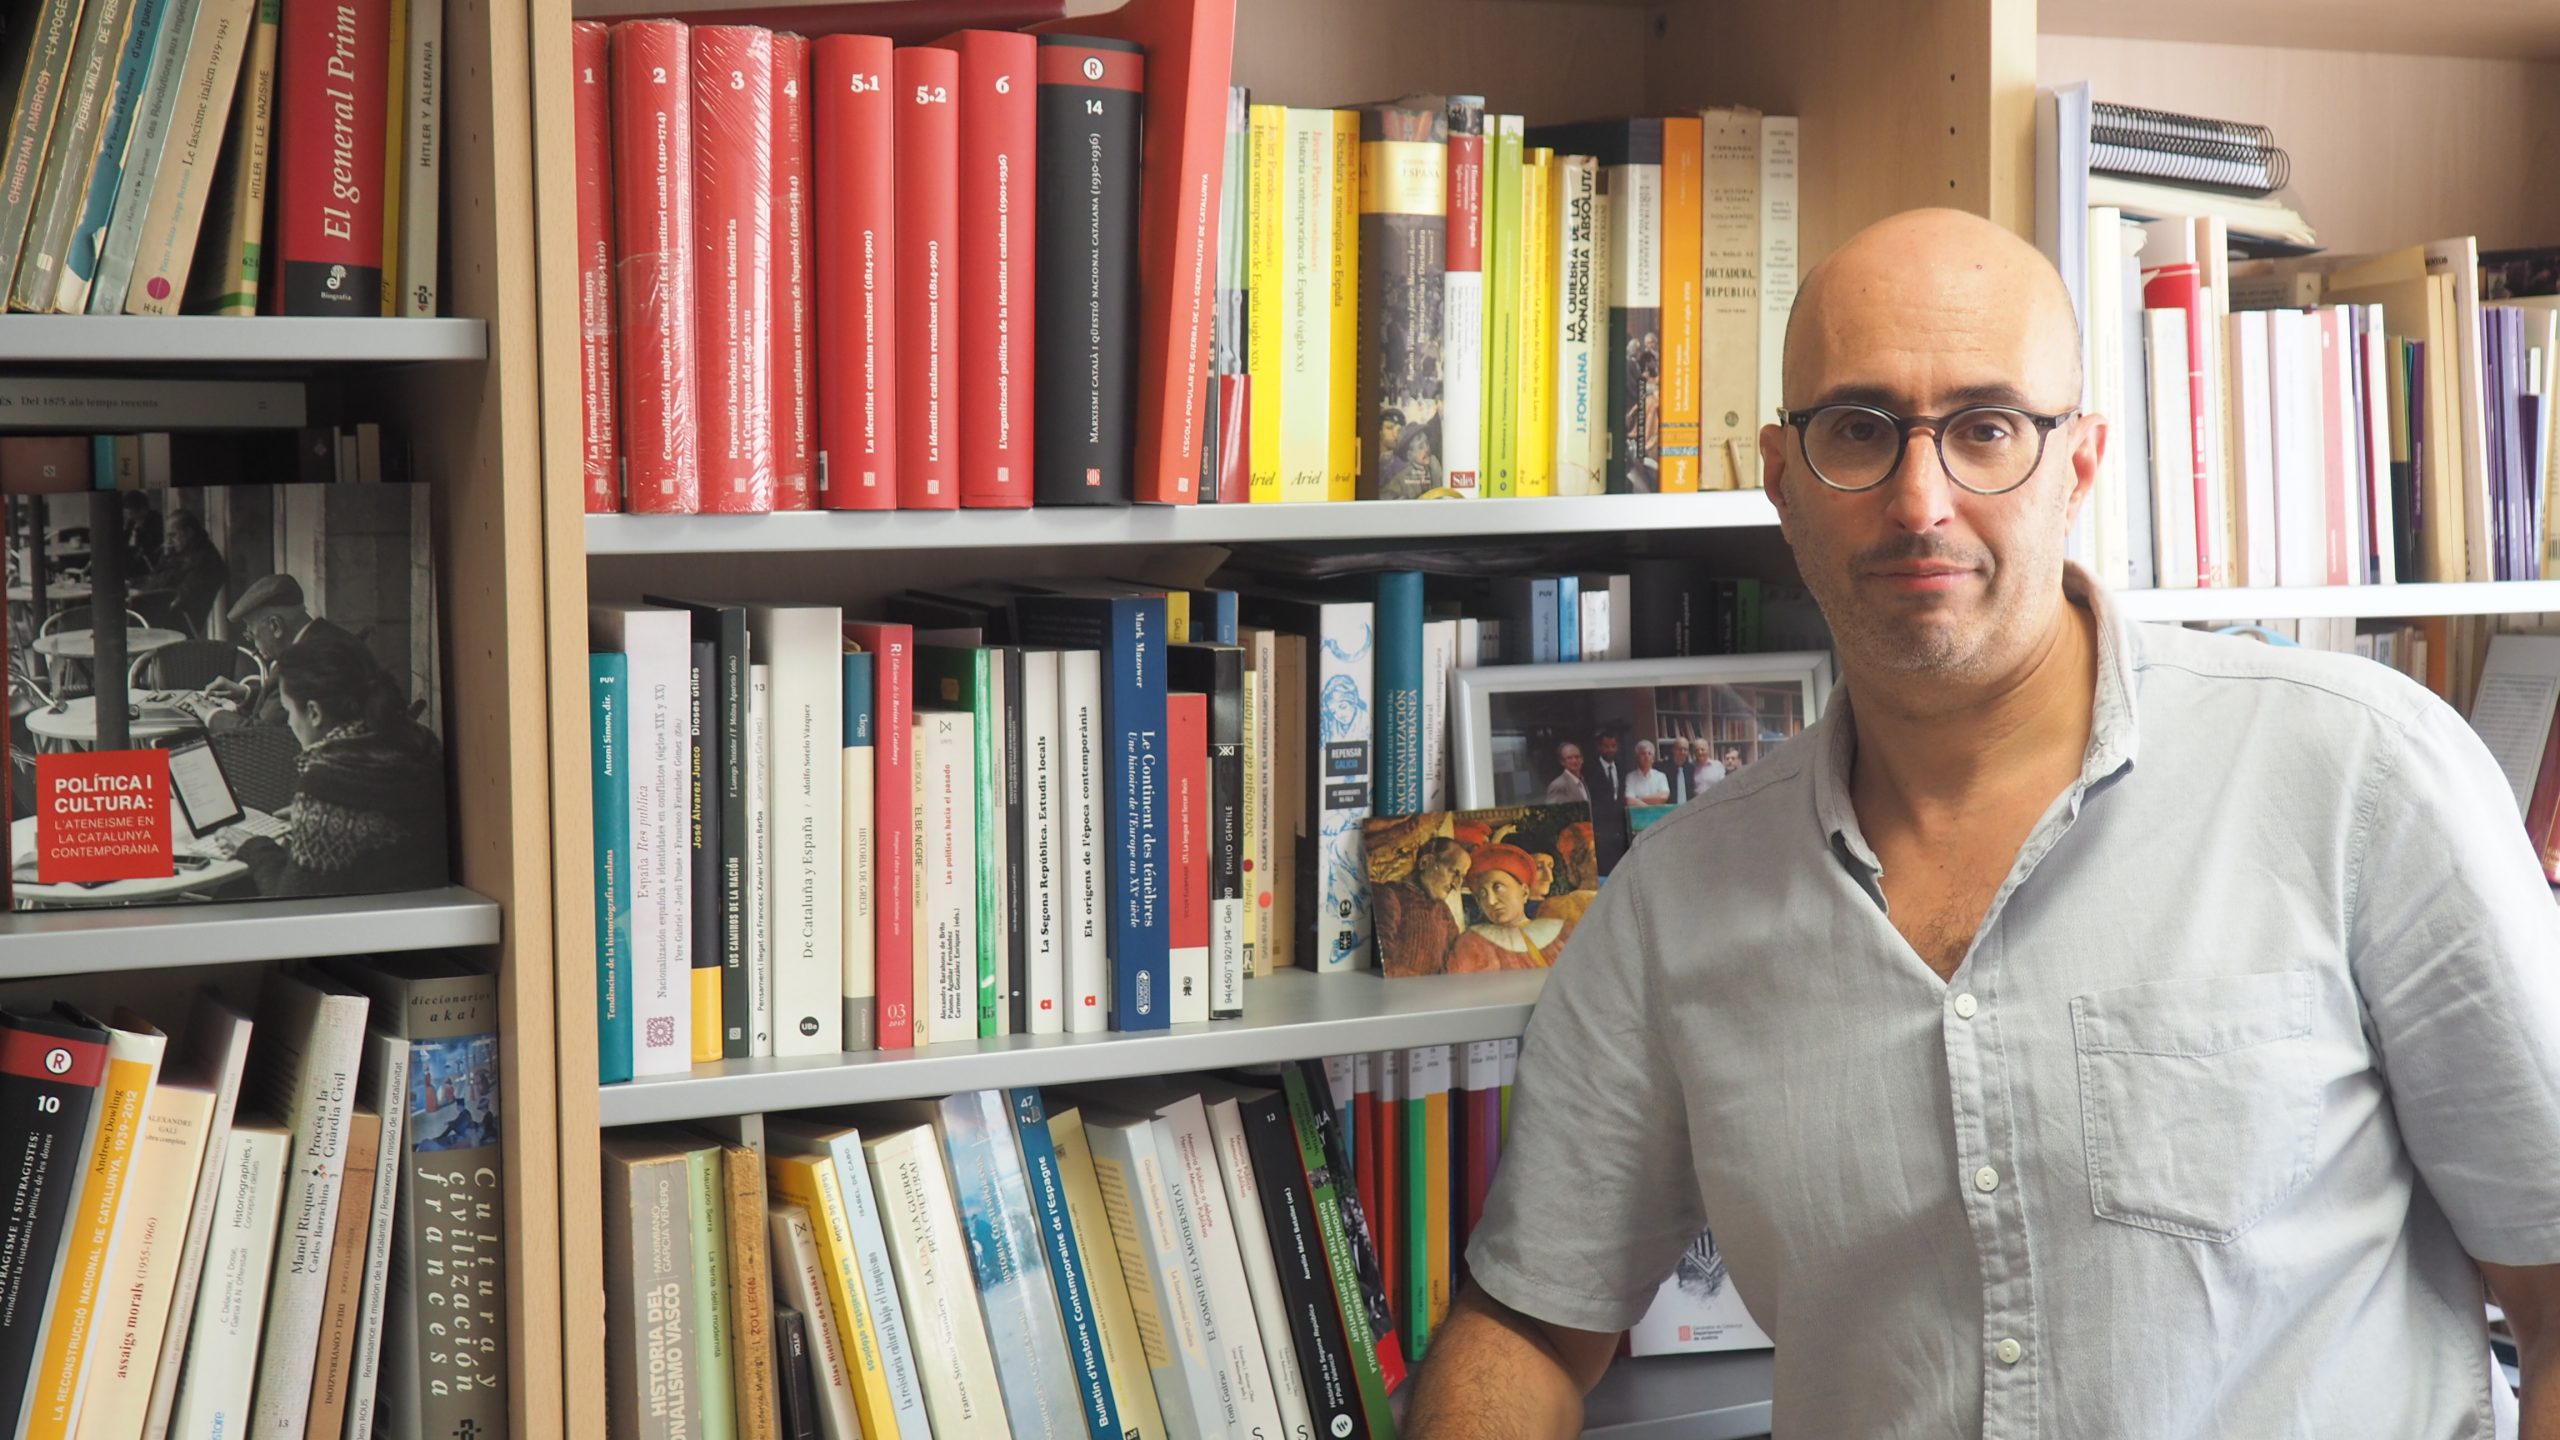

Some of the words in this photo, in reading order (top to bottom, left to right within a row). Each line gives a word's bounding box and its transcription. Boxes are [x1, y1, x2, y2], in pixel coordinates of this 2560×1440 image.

[207, 16, 228, 65] 1919-1945
[327, 5, 356, 82] Prim
[198, 66, 216, 101] italien
[421, 41, 432, 106] ALEMANIA
[584, 67, 593, 83] 1
[653, 66, 667, 84] 2
[730, 70, 745, 90] 3
[783, 80, 798, 99] 4
[851, 73, 881, 93] 5.1
[995, 75, 1010, 94] 6
[257, 69, 269, 119] NAZISME
[916, 85, 947, 105] 5.2
[1086, 100, 1103, 115] 14
[187, 101, 208, 148] fascisme
[255, 123, 265, 137] LE
[182, 149, 196, 166] Le
[254, 142, 264, 157] ET
[326, 87, 360, 204] general
[420, 123, 431, 167] HITLER
[251, 161, 263, 199] HITLER
[998, 154, 1008, 213] (1901-1936)
[1198, 173, 1209, 223] CATALUNYA
[324, 206, 351, 241] El
[1569, 198, 1580, 217] LA
[998, 214, 1007, 259] catalana
[1198, 225, 1205, 236] DE
[1569, 223, 1579, 242] DE
[864, 230, 874, 290] (1814-1901)
[1193, 237, 1204, 296] GENERALITAT
[998, 260, 1007, 305] identitat
[1576, 248, 1591, 343] MONARQUIA
[864, 291, 873, 343] renaixent
[998, 307, 1007, 317] la
[1192, 297, 1200, 309] LA
[1192, 311, 1199, 323] DE
[998, 319, 1008, 332] de
[1189, 324, 1198, 360] GUERRA
[1566, 322, 1577, 342] LA
[864, 344, 874, 390] catalana
[998, 333, 1010, 374] política
[1188, 361, 1196, 373] DE
[1185, 374, 1195, 416] POPULAR
[1575, 352, 1588, 434] J.FONTANA
[864, 391, 874, 436] identitat
[998, 375, 1010, 450] L'organització
[864, 439, 874, 454] La
[1182, 417, 1192, 457] L'ESCOLA
[1136, 611, 1144, 638] Mark
[691, 667, 700, 697] útiles
[1137, 642, 1145, 688] Mazower
[691, 700, 700, 739] Dioses
[803, 704, 812, 738] Vázquez
[803, 739, 811, 766] Sotelo
[1037, 736, 1046, 769] locals
[1079, 706, 1092, 799] contemporània
[1143, 731, 1156, 749] Le
[691, 745, 701, 778] Junco
[55, 773, 142, 794] POLÍTICA
[146, 775, 152, 791] I
[803, 767, 811, 796] Adolfo
[1038, 774, 1047, 819] Estudis
[1143, 753, 1156, 828] Continent
[55, 795, 153, 813] CULTURA:
[636, 785, 651, 825] publica
[690, 781, 701, 820] Álvarez
[55, 817, 134, 829] L'ATENEISME
[138, 815, 155, 826] EN
[58, 831, 75, 843] LA
[78, 829, 151, 842] CATALUNYA
[692, 823, 701, 849] José
[802, 816, 816, 863] España
[1081, 803, 1093, 845] l'època
[51, 843, 160, 858] CONTEMPORÀNIA
[636, 830, 649, 851] Res
[1038, 823, 1050, 887] República.
[1082, 851, 1091, 865] de
[1143, 833, 1156, 858] des
[605, 849, 614, 885] catalana
[725, 857, 738, 887] NACIÓN
[1225, 843, 1233, 875] EMILIO
[637, 856, 652, 899] España
[728, 889, 738, 900] LA
[1083, 869, 1094, 915] origens
[1143, 862, 1156, 927] ténèbres
[605, 886, 616, 946] historiografia
[728, 901, 739, 911] DE
[802, 878, 813, 937] Cataluña
[1039, 892, 1051, 935] Segona
[728, 913, 739, 951] CAMINOS
[1040, 939, 1049, 954] La
[1084, 919, 1093, 938] Els
[606, 947, 615, 956] la
[606, 957, 615, 969] de
[728, 952, 739, 968] LOS
[802, 941, 814, 959] De
[606, 970, 615, 1020] Tendències
[37, 1096, 60, 1114] 10
[315, 1089, 328, 1100] la
[330, 1071, 346, 1103] Civil
[95, 1134, 113, 1174] Andrew
[104, 1088, 125, 1132] Dowling
[113, 1088, 137, 1152] 1939-2012
[308, 1115, 325, 1157] Procés
[324, 1105, 342, 1158] Guàrdia
[96, 1153, 124, 1226] CATALUNYA,
[1036, 1155, 1061, 1215] l'Espagne
[1283, 1187, 1296, 1204] (ed.)
[296, 1181, 317, 1232] Risques
[313, 1183, 329, 1237] Barrachina
[1050, 1215, 1063, 1231] de
[1171, 1182, 1196, 1256] MODERNITAT
[1287, 1204, 1301, 1233] Bataller
[92, 1225, 106, 1244] DE
[135, 1215, 157, 1279] (1955-1966)
[1293, 1233, 1305, 1254] Martí
[291, 1234, 307, 1273] Manel
[308, 1240, 322, 1273] Carles
[473, 1167, 497, 1354] Cultura
[1188, 1256, 1200, 1272] LA
[1297, 1252, 1311, 1281] Aurelio
[78, 1245, 102, 1304] NACIONAL
[418, 1167, 448, 1397] francesa
[448, 1171, 475, 1390] civilización
[1054, 1231, 1086, 1322] Contemporaine
[1192, 1273, 1204, 1289] DE
[126, 1281, 144, 1328] morals
[647, 1286, 662, 1322] DEL
[663, 1282, 681, 1343] VASCO
[1196, 1289, 1213, 1327] SOMNI
[1075, 1322, 1098, 1381] d'Histoire
[1205, 1327, 1216, 1342] EL
[54, 1305, 88, 1402] RECONSTRUCCIÓ
[117, 1331, 137, 1379] assaigs
[649, 1325, 666, 1417] HISTORIA
[477, 1374, 497, 1388] y
[52, 1403, 65, 1420] LA
[1089, 1380, 1109, 1428] Bulletin
